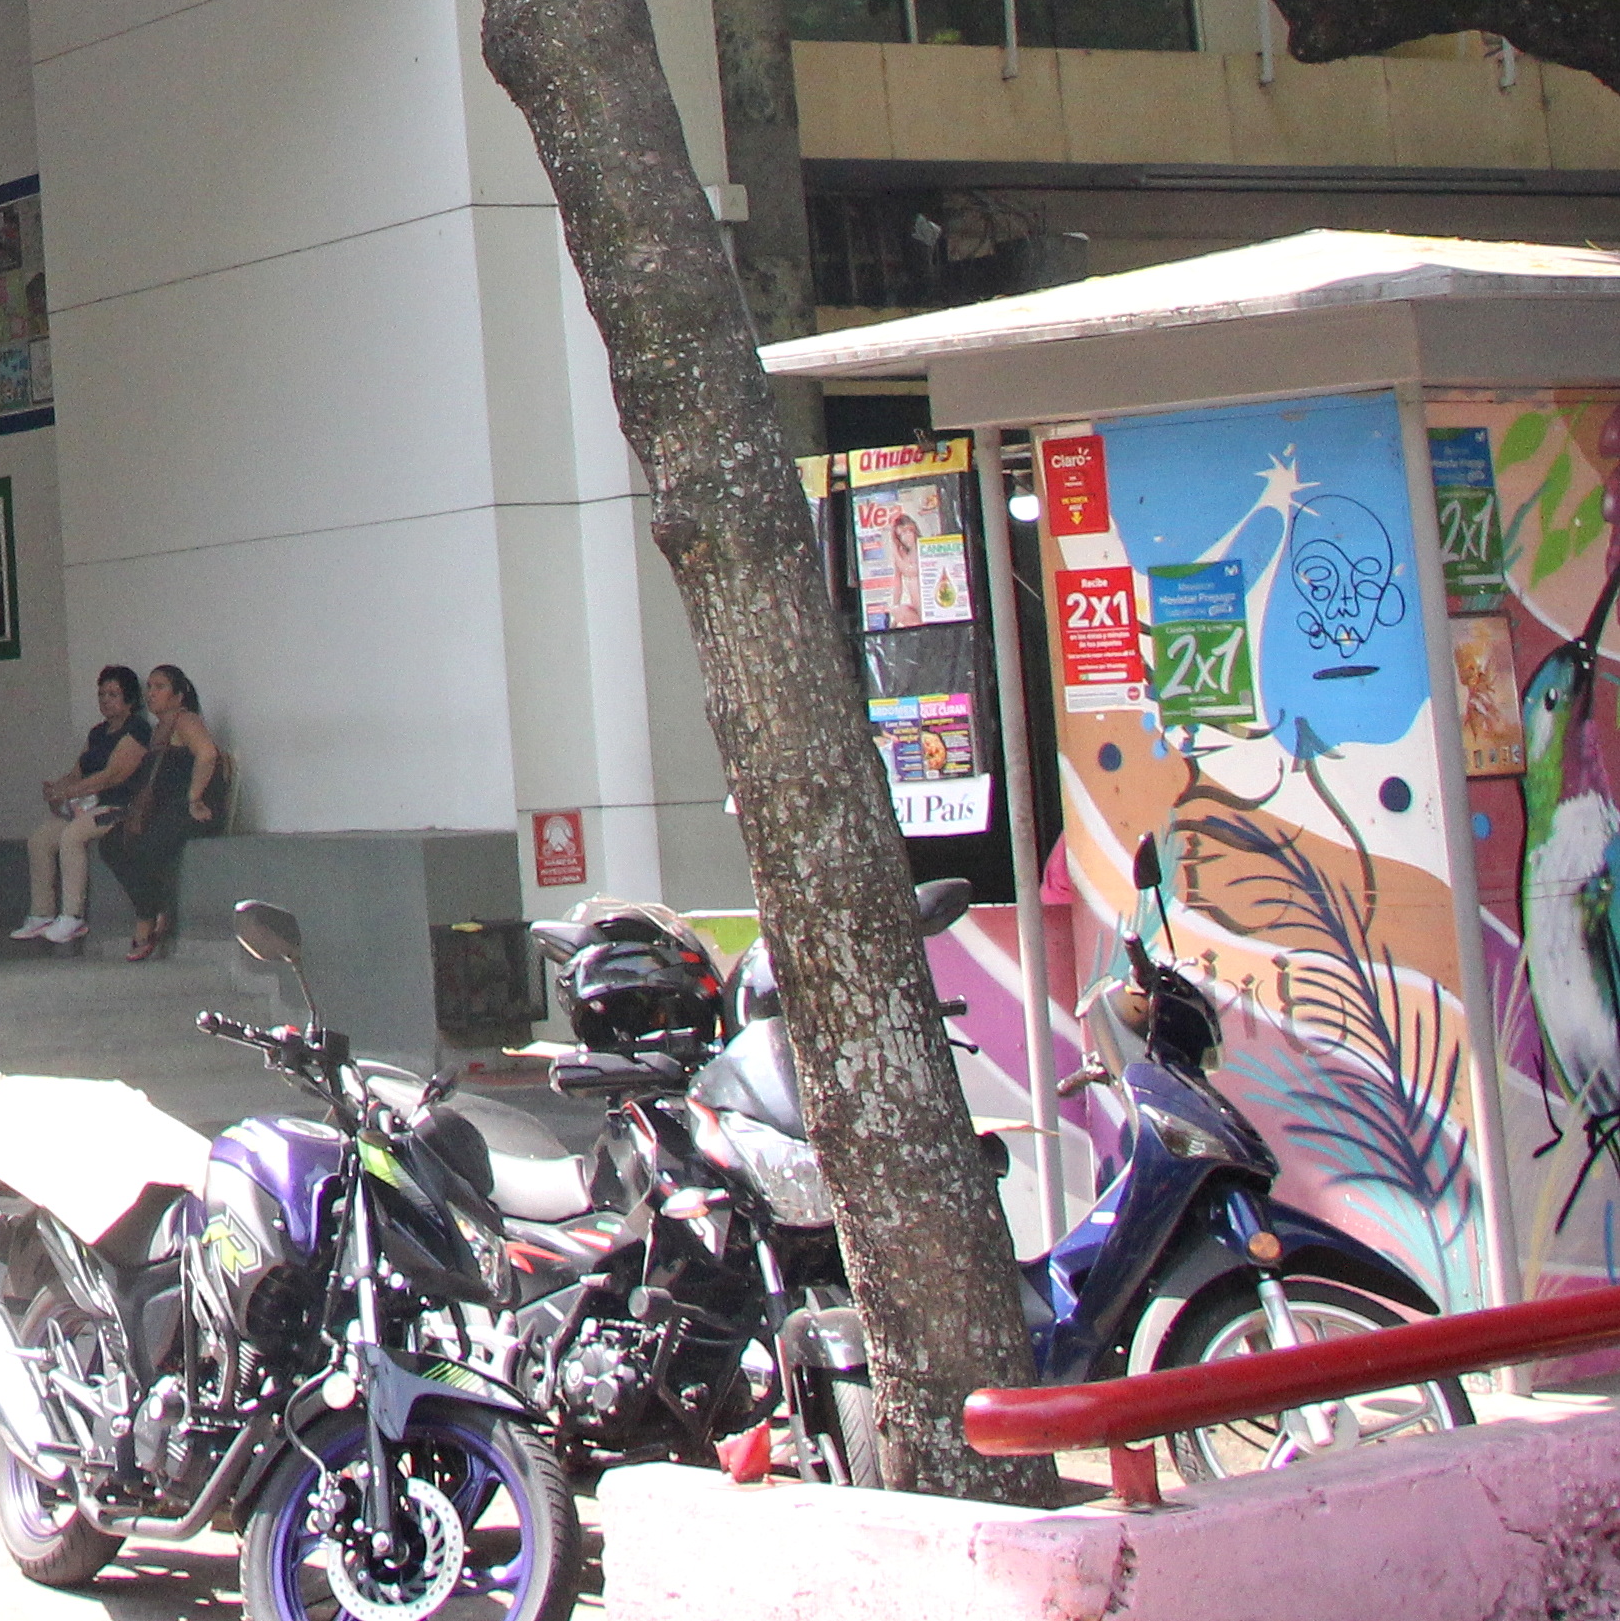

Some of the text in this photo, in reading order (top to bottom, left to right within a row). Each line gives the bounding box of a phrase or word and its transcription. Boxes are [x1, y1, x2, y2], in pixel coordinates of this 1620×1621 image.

[1051, 451, 1087, 468] Claro
[1439, 493, 1495, 563] 2x1
[1081, 578, 1108, 588] Recibe
[1065, 590, 1130, 629] 2x1
[1159, 626, 1245, 700] 2x1
[924, 793, 975, 824] País
